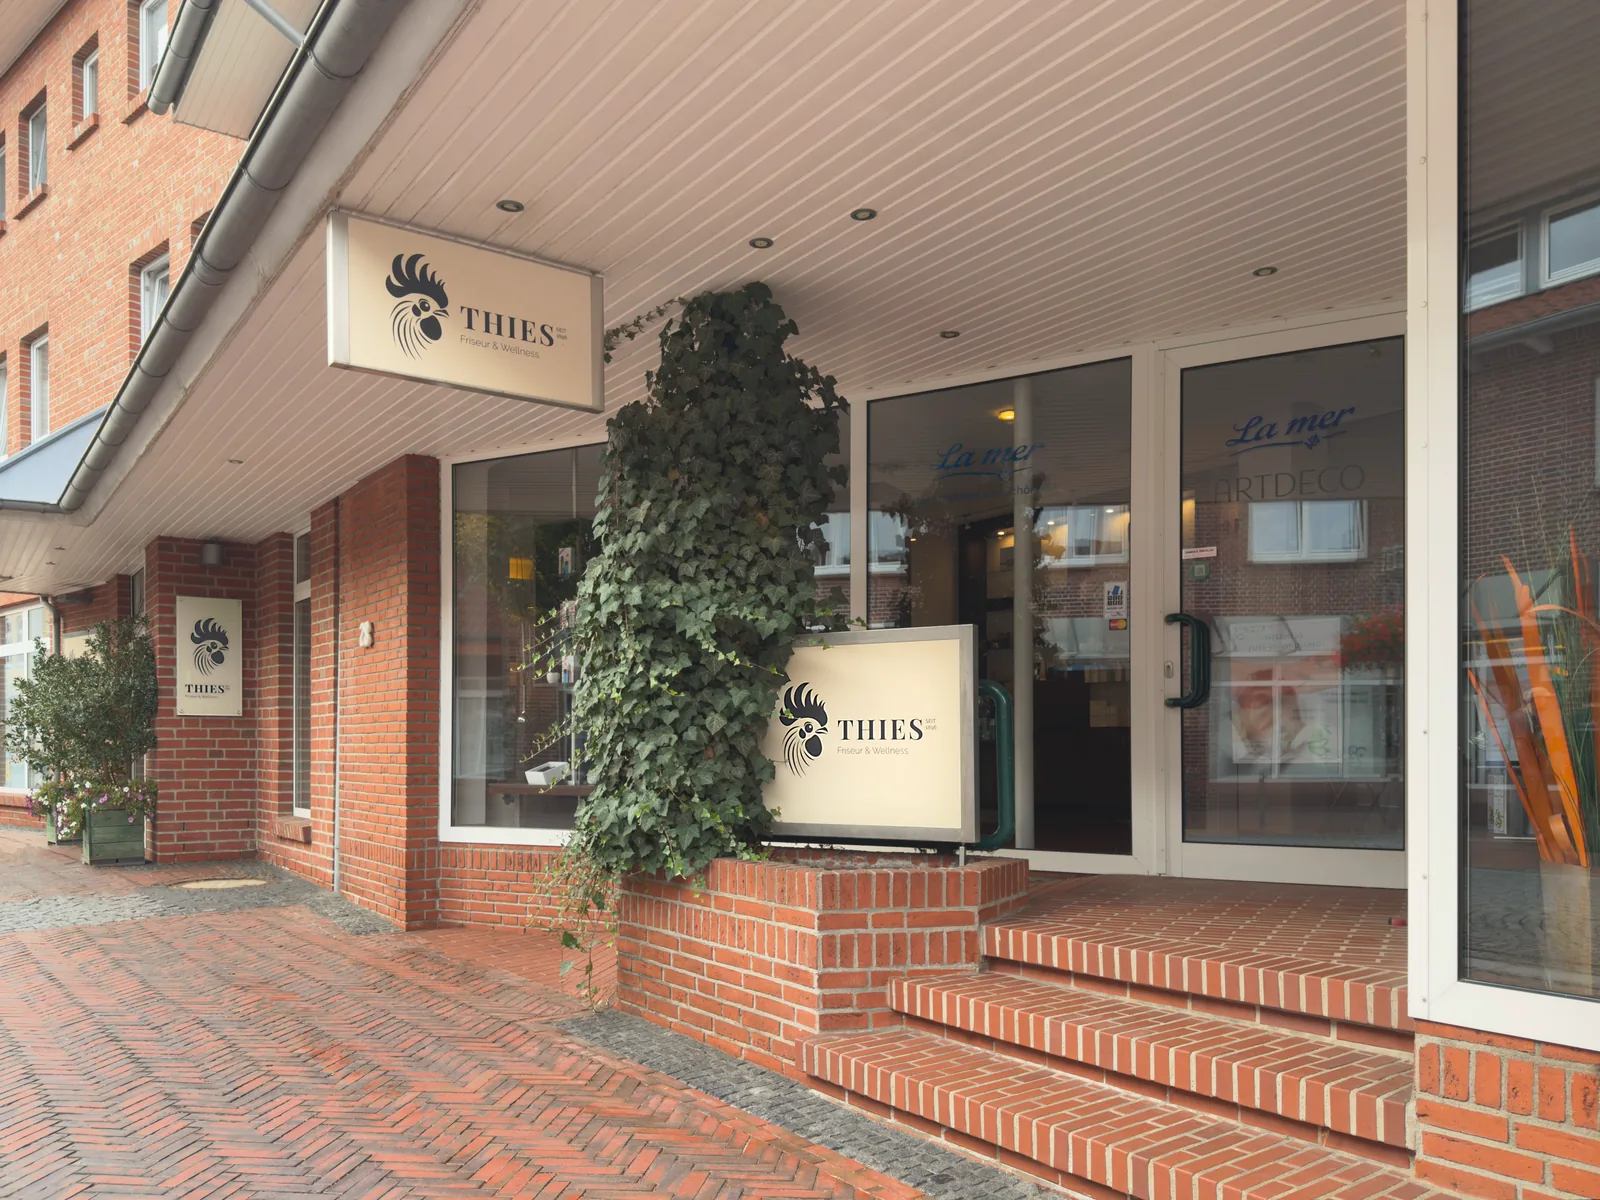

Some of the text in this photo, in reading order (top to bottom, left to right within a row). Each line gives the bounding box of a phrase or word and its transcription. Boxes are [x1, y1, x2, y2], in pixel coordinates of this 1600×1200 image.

[460, 305, 555, 347] THIES
[460, 334, 540, 359] Friseur & Wellness
[1225, 406, 1356, 447] La mer
[935, 441, 1046, 470] La mer
[1213, 464, 1366, 503] ARTDECO
[184, 684, 225, 693] THIES
[837, 718, 924, 741] THIES
[837, 746, 909, 755] Friseur & Wellness
